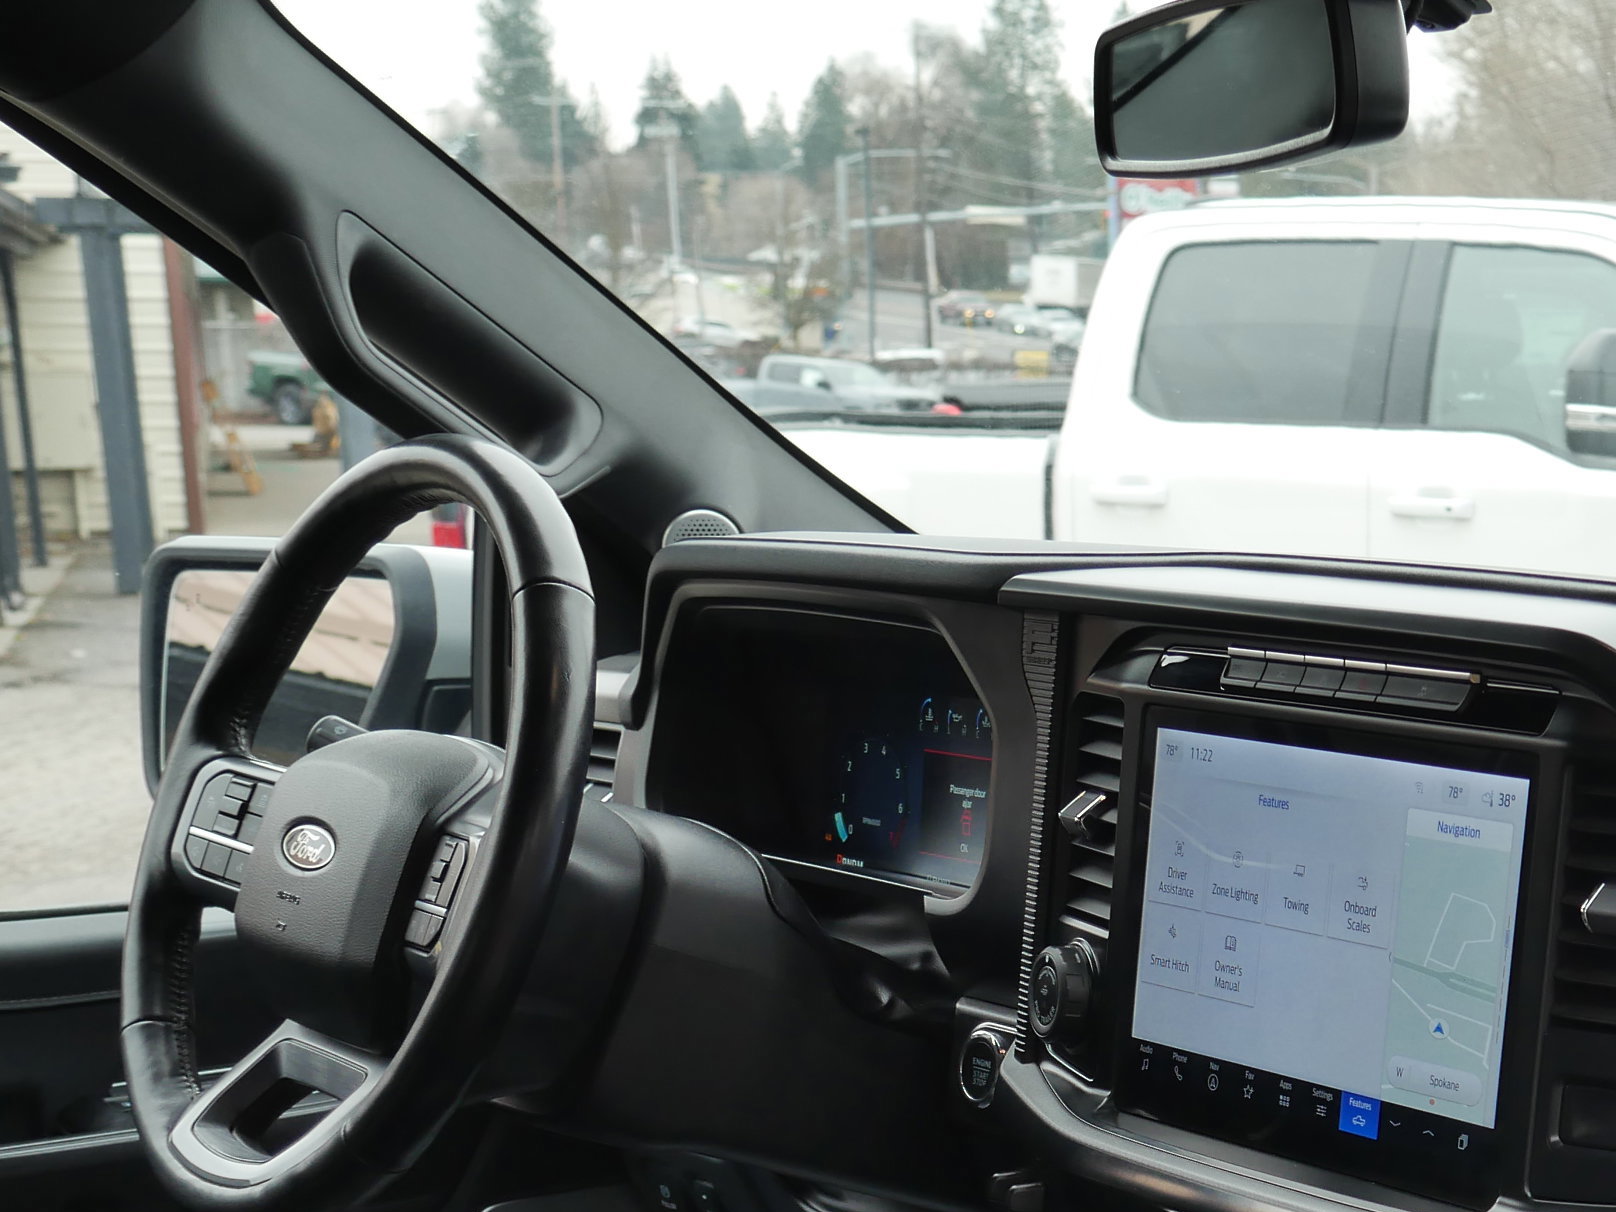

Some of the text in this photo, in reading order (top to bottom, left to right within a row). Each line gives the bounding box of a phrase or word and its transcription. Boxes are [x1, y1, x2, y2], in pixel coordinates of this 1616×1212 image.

[863, 742, 869, 754] 3
[880, 745, 887, 756] 4
[1166, 744, 1213, 763] 78° 11:22
[847, 761, 852, 772] 2
[895, 768, 901, 779] 5
[1258, 794, 1290, 810] Features
[1448, 786, 1516, 808] 78° 38°
[898, 803, 903, 814] 6
[848, 824, 854, 835] 0
[1437, 821, 1481, 839] Navigation
[289, 829, 326, 863] Ford
[1167, 866, 1187, 881] Driver
[1158, 882, 1194, 898] Assistance
[1212, 883, 1259, 905] Zone Lighting
[1283, 896, 1310, 915] Towing
[1344, 900, 1377, 918] Onboard
[1347, 918, 1371, 934] Scales
[1150, 954, 1190, 973] Smart Hitch
[1214, 960, 1243, 977] Owner's
[1214, 976, 1240, 992] Manual
[1139, 1044, 1153, 1055] Audio
[972, 1056, 992, 1069] ENGINE
[1172, 1052, 1188, 1064] Phone
[1209, 1061, 1220, 1072] Nav
[1279, 1079, 1292, 1091] Apps
[1396, 1066, 1460, 1092] W Spokane
[1312, 1088, 1334, 1102] Settings
[1348, 1097, 1372, 1111] Features
